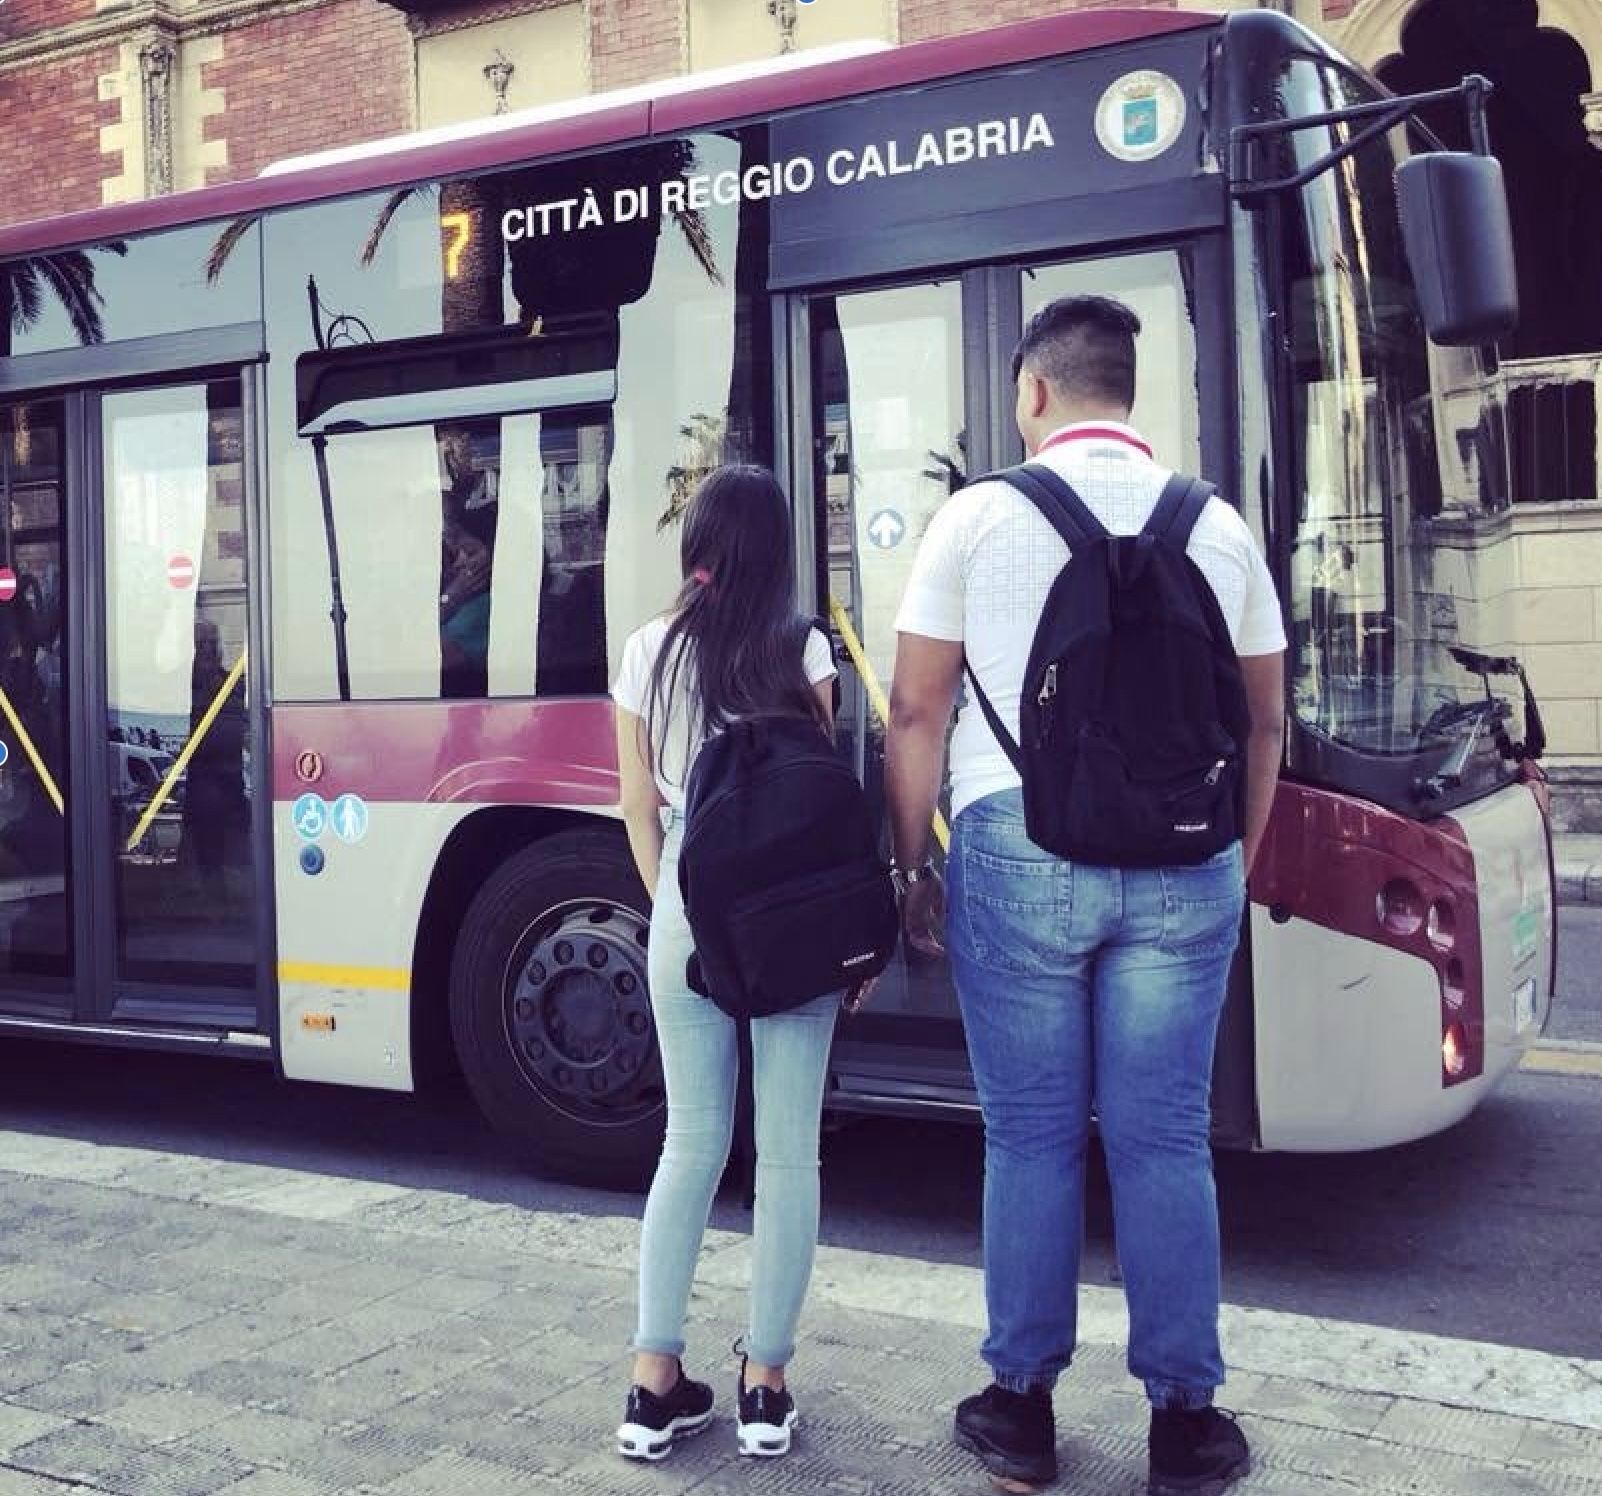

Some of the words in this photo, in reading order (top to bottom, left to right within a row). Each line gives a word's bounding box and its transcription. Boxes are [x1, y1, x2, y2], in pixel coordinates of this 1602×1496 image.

[501, 187, 604, 242] CITTÀ
[613, 186, 649, 223] DI
[660, 156, 815, 214] REGGIO
[826, 112, 1055, 186] CALABRIA
[441, 212, 469, 278] 7
